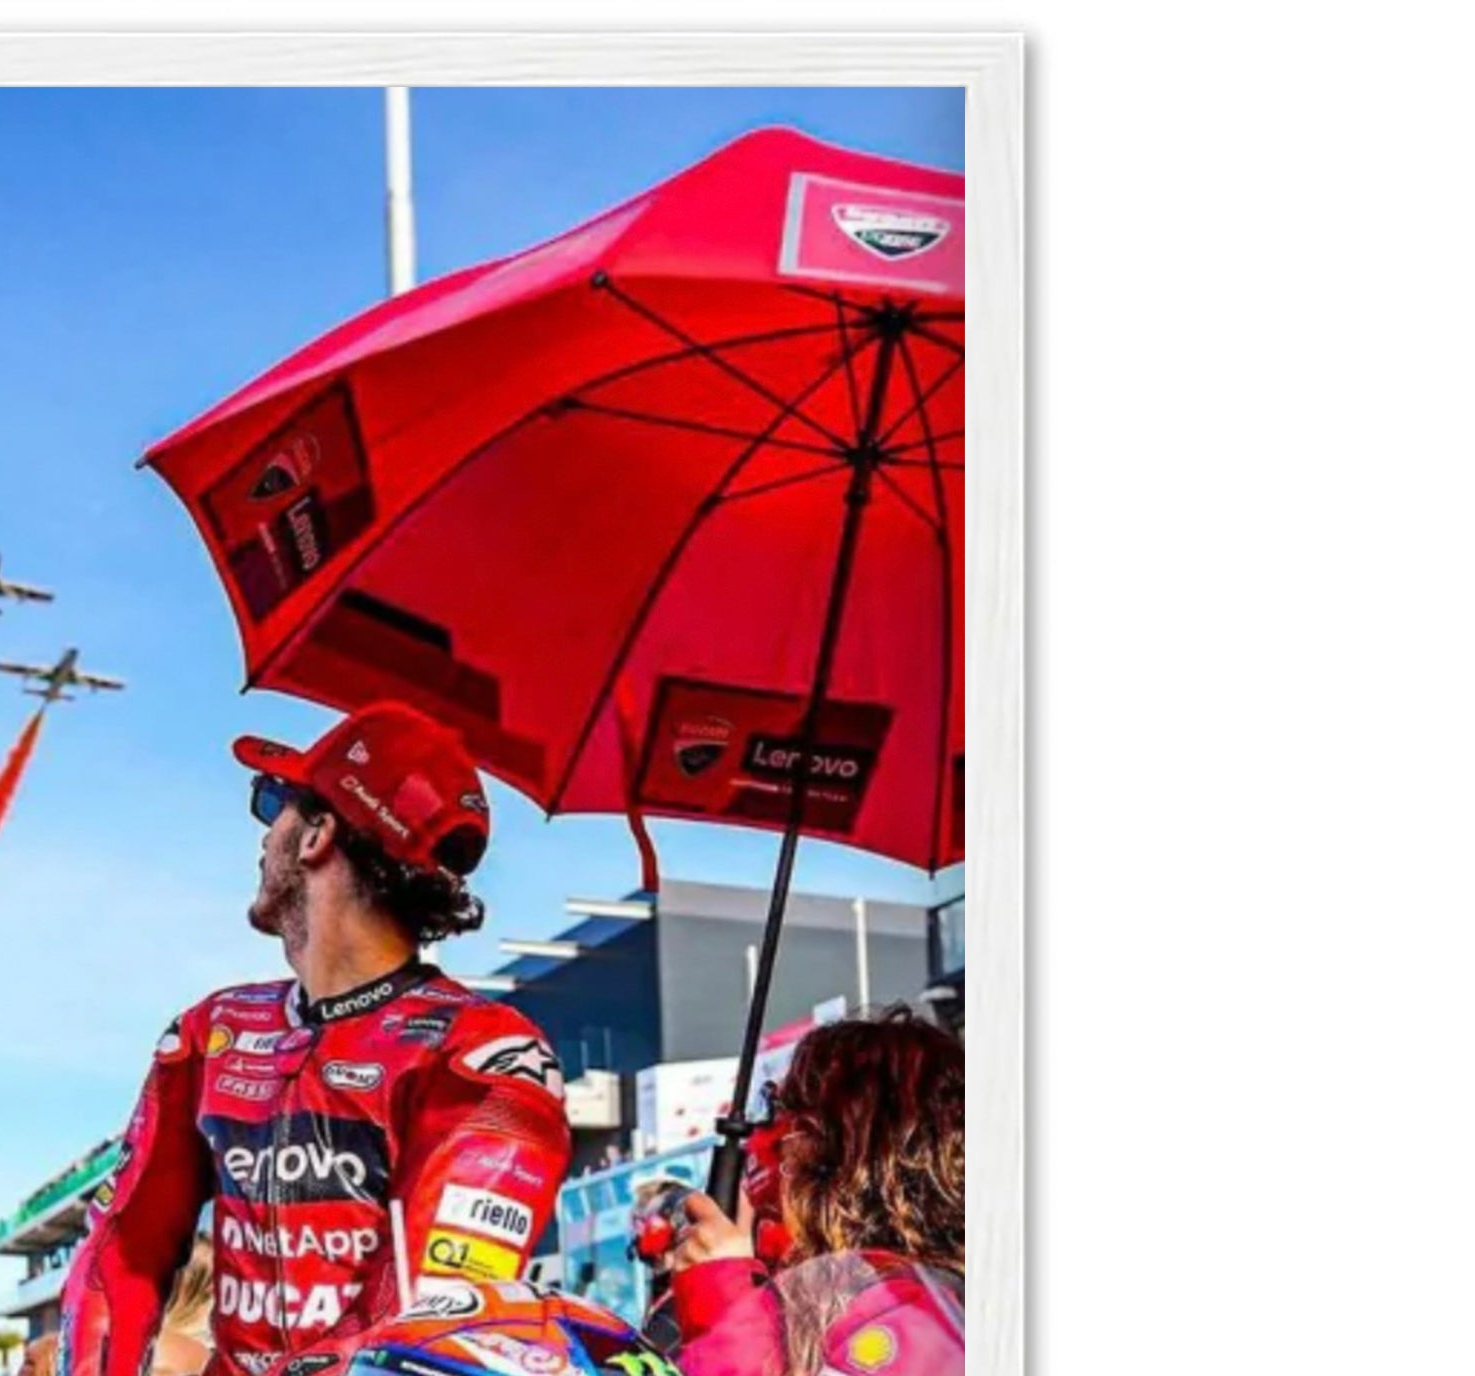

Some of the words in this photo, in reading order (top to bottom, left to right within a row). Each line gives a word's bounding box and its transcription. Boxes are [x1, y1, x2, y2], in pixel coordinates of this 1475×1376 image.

[321, 982, 393, 1020] Lenovo
[208, 1135, 367, 1187] enovo
[470, 1198, 528, 1236] riello
[244, 1223, 379, 1263] NetApp
